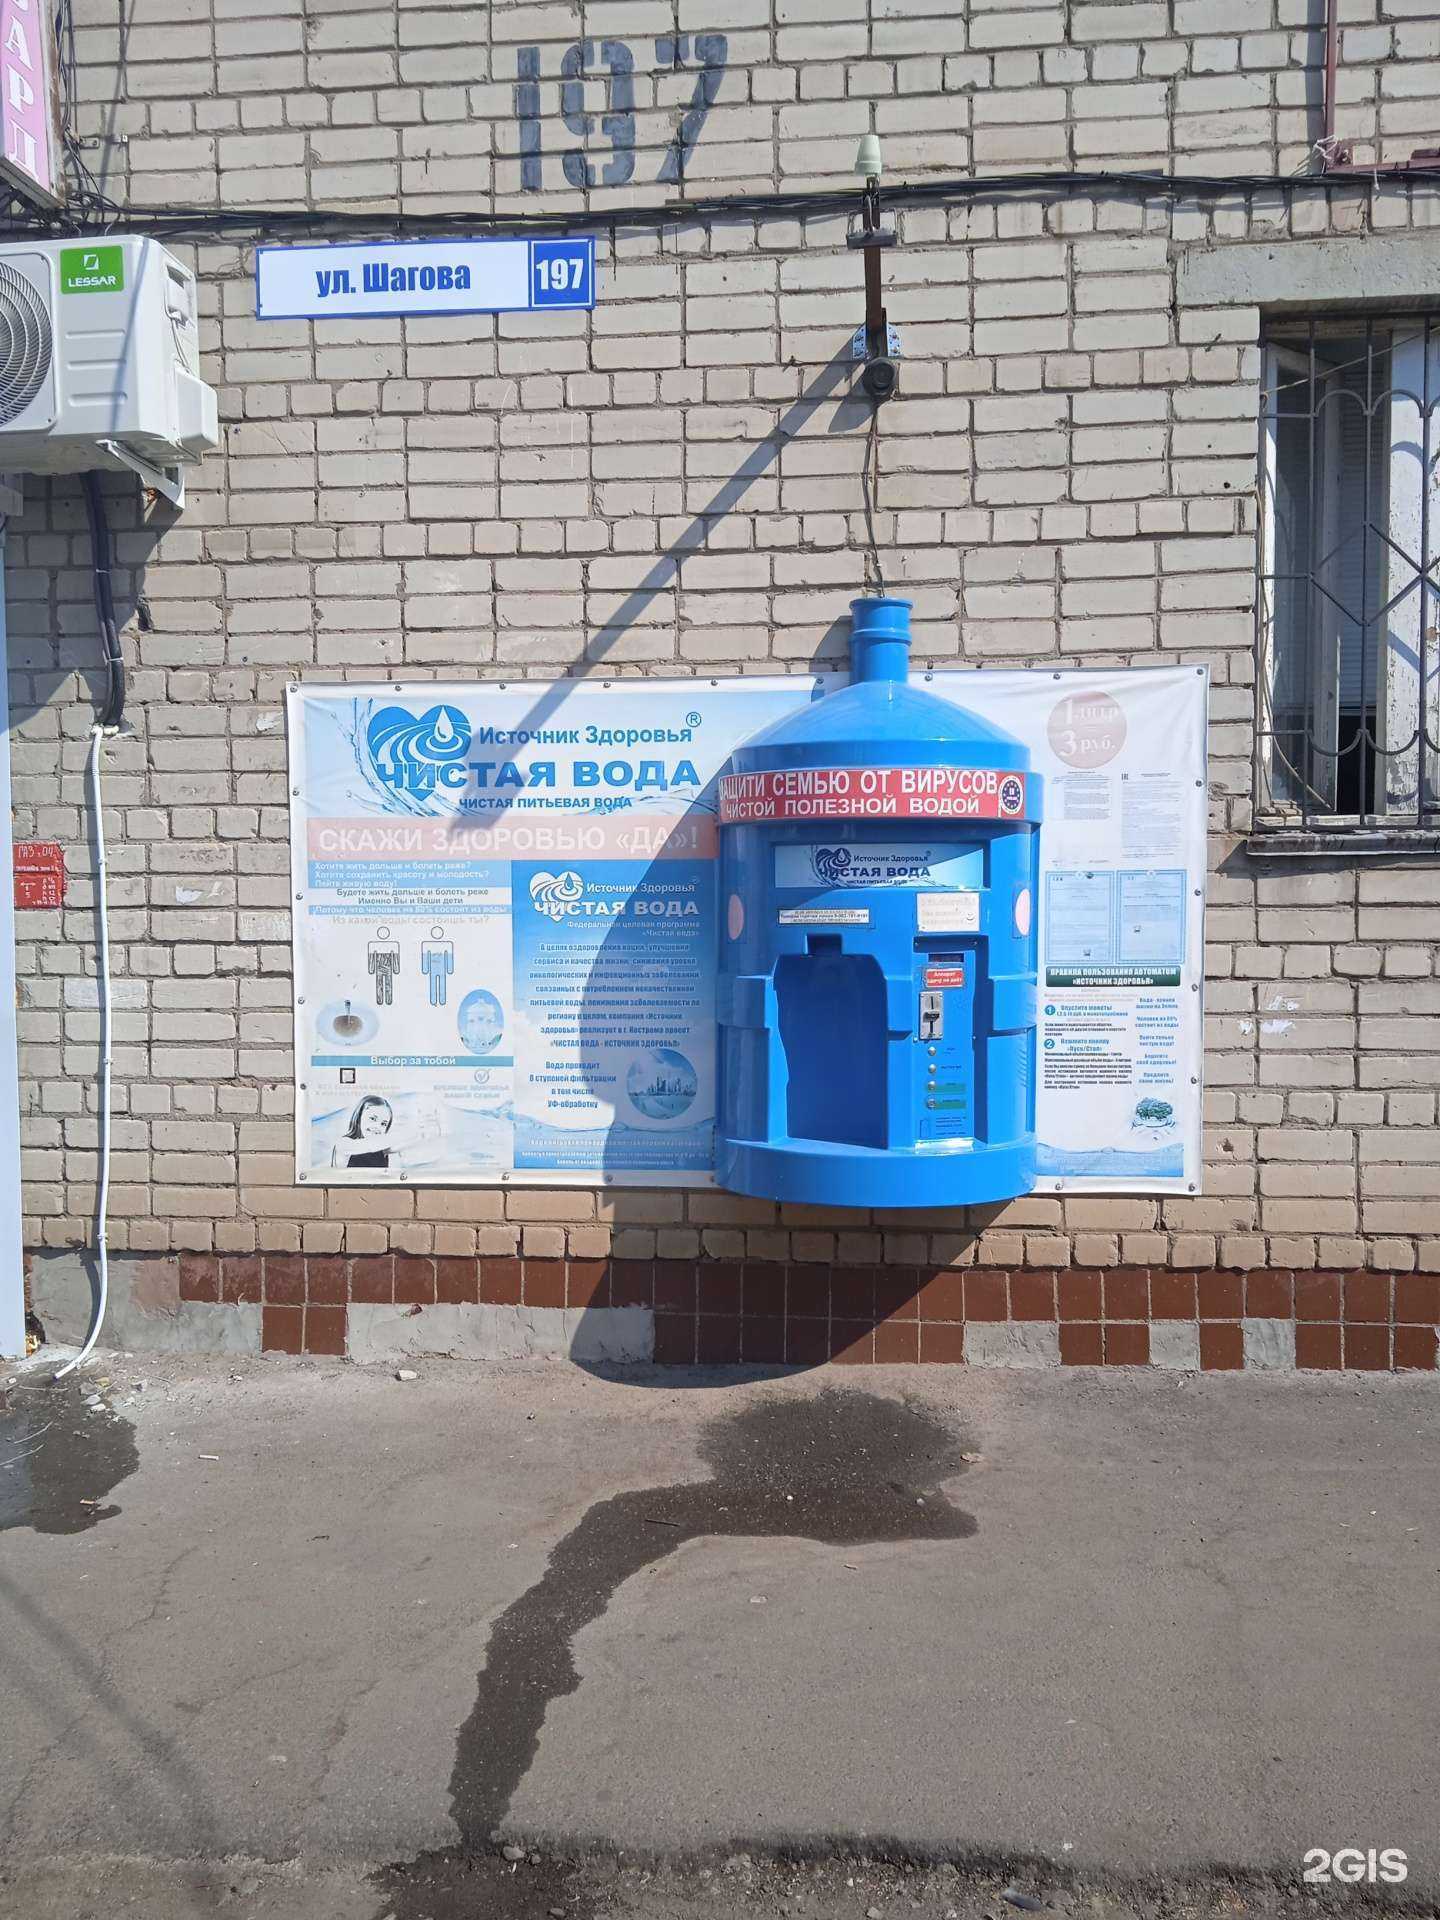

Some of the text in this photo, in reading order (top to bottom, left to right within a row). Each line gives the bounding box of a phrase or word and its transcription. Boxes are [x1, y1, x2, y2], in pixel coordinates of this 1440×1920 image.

[517, 34, 728, 191] 197
[68, 276, 116, 287] LESSAR
[315, 262, 471, 297] ул. Шагова
[535, 257, 583, 290] 197
[479, 724, 692, 747] Источник Здоровья
[1058, 729, 1077, 756] 3
[377, 761, 701, 792] ЧИСТАЯ ВОДА
[773, 771, 850, 796] СЕМЬЮ
[860, 770, 891, 793] ОТ
[902, 770, 998, 795] ВИРУСОВ
[459, 797, 632, 809] ЧИСТАЯ ПИТЬЕВАЯ ВОДА
[726, 795, 980, 819] ЧИСТОЙ ПОЛЕЗНОЙ ВОДОЙ
[319, 829, 422, 854] СКАЖИ
[436, 828, 606, 855] ЗДОРОВЬЮ
[315, 862, 344, 871] Хотите
[369, 862, 401, 871] дольше
[412, 862, 442, 871] болеть
[891, 854, 928, 863] Здоровья
[886, 867, 931, 879] ВОДА
[336, 888, 366, 897] Будете
[587, 882, 695, 895] Источник Здоровья
[417, 897, 441, 906] Ваши
[535, 900, 700, 917] ЧИСТАЯ ВОДА
[371, 1056, 407, 1067] Выбор
[409, 1056, 422, 1067] за
